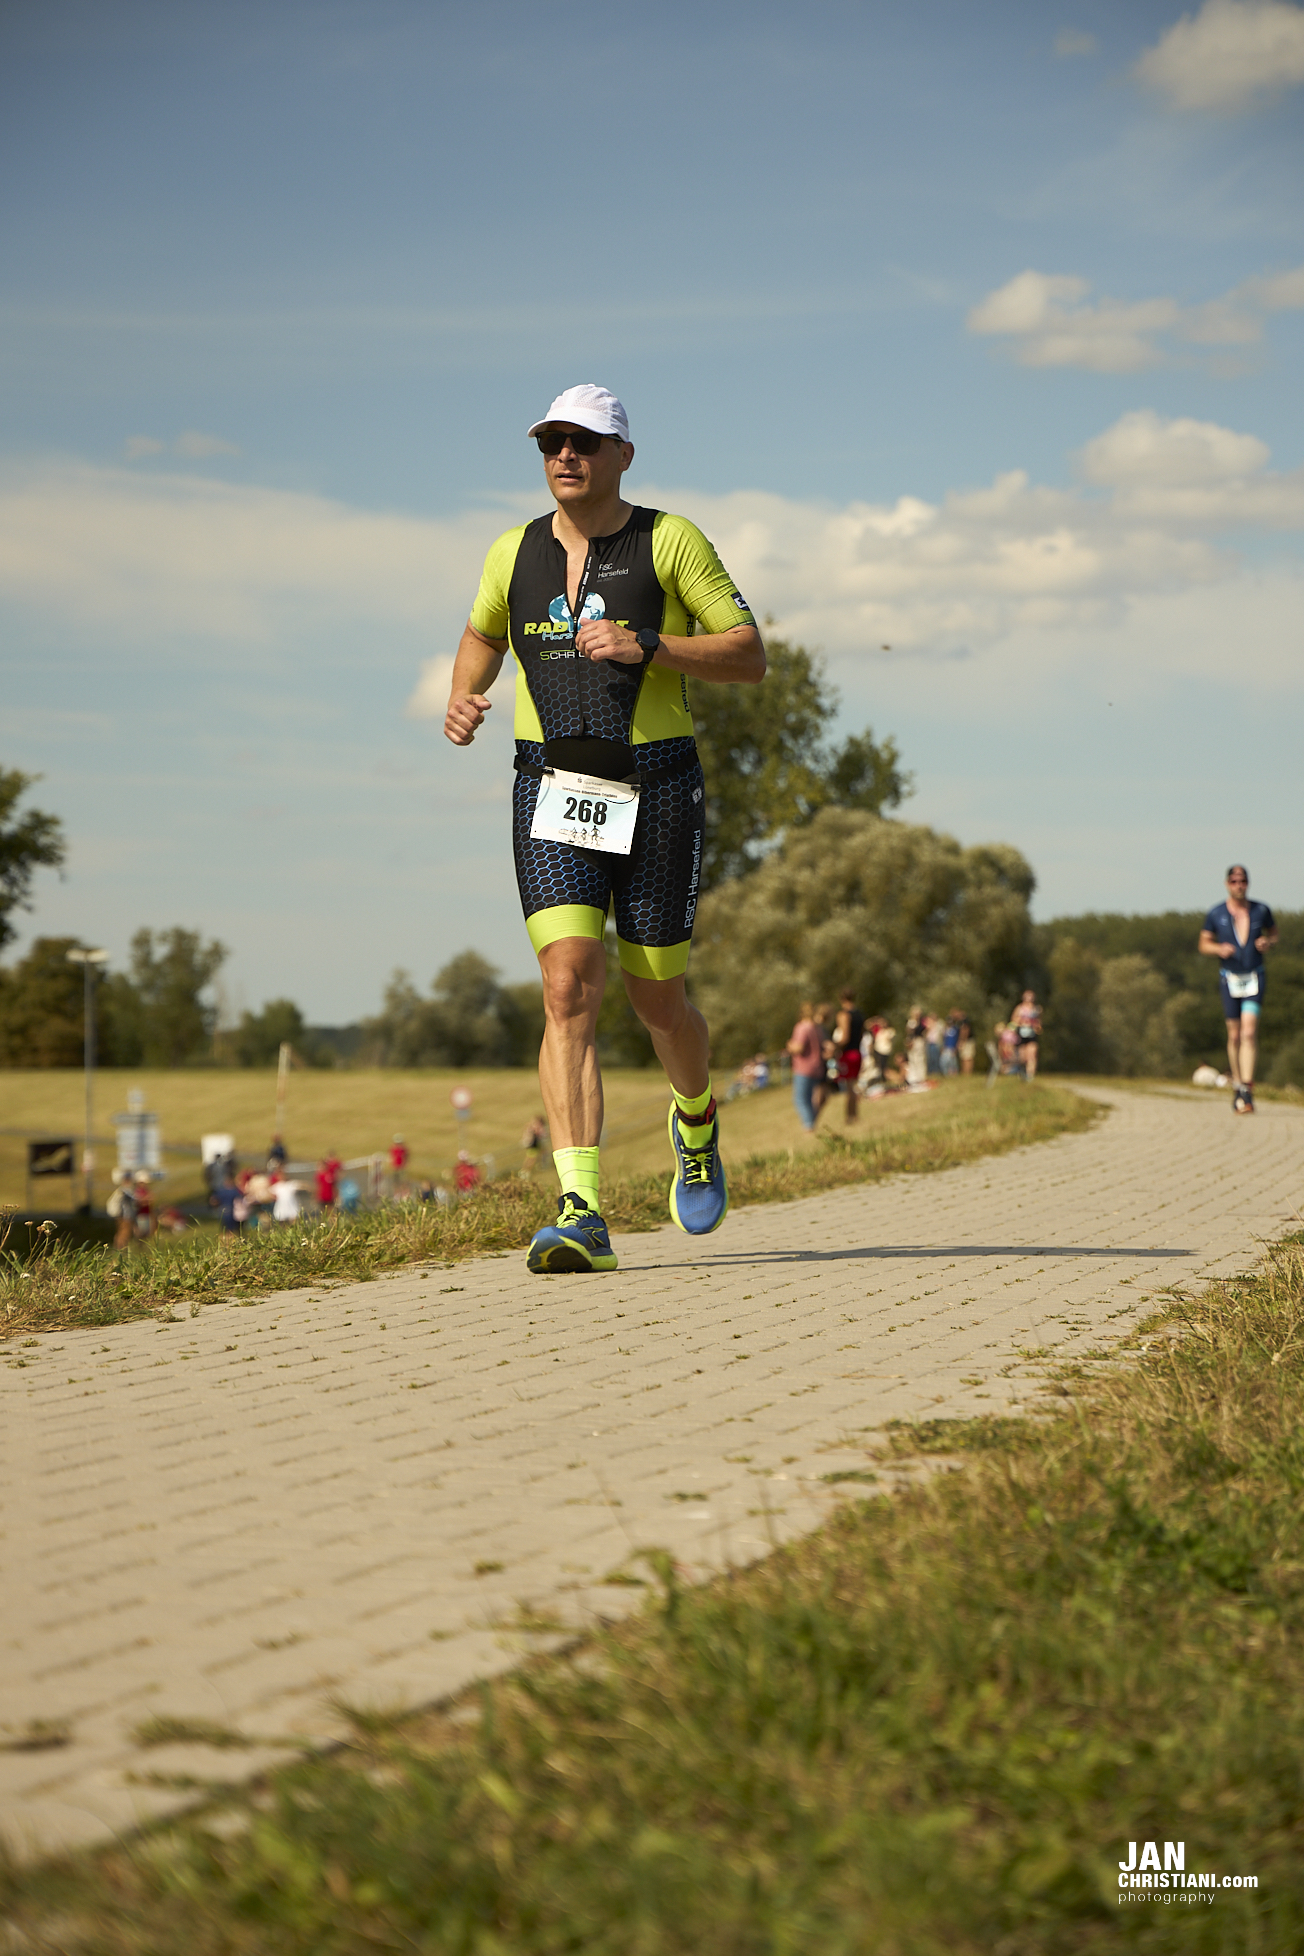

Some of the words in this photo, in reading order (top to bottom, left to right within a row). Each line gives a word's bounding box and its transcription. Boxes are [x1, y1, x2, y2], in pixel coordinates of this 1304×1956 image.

[597, 568, 629, 579] Harsefeld
[686, 613, 694, 637] RS
[563, 796, 608, 826] 268
[688, 829, 701, 896] Harsefeld
[684, 898, 696, 928] RSC
